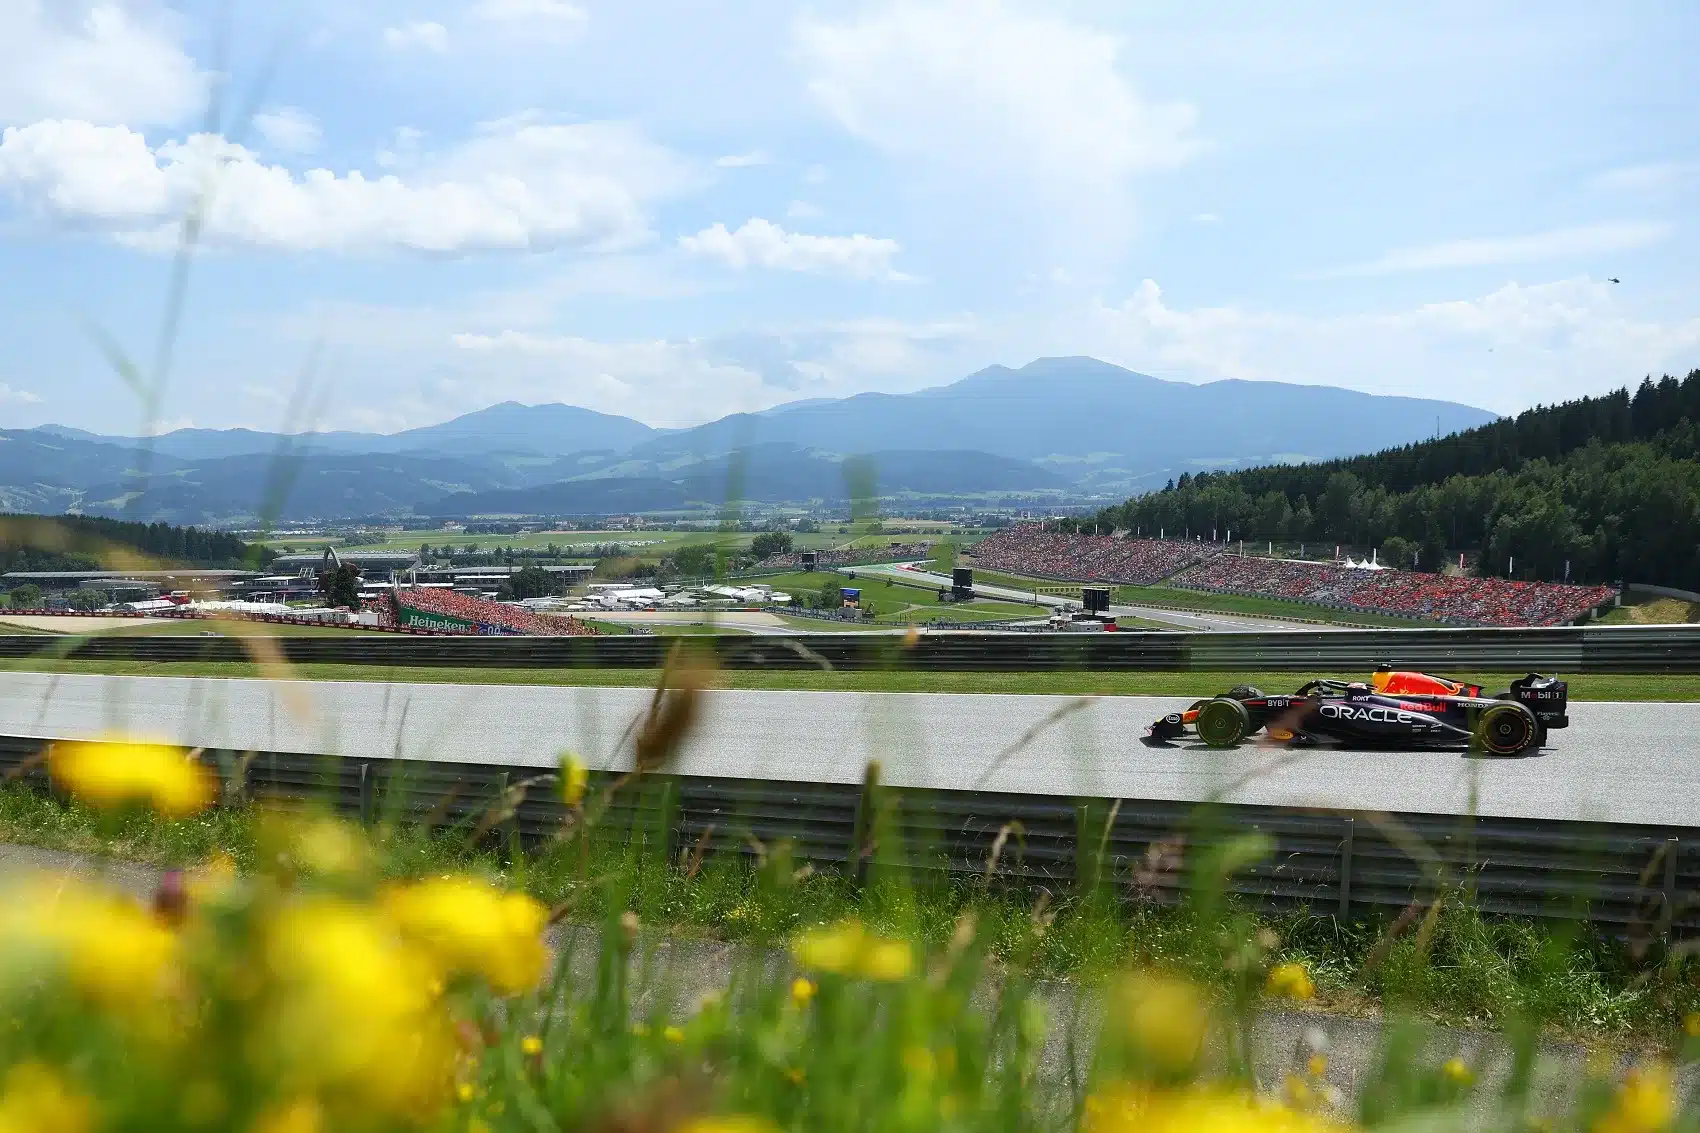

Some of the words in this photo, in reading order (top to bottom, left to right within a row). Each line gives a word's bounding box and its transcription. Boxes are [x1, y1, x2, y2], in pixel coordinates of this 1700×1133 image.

[409, 615, 468, 632] Heineken
[1320, 706, 1413, 724] ORACLE
[1400, 701, 1423, 711] Red
[1424, 702, 1446, 712] Bull
